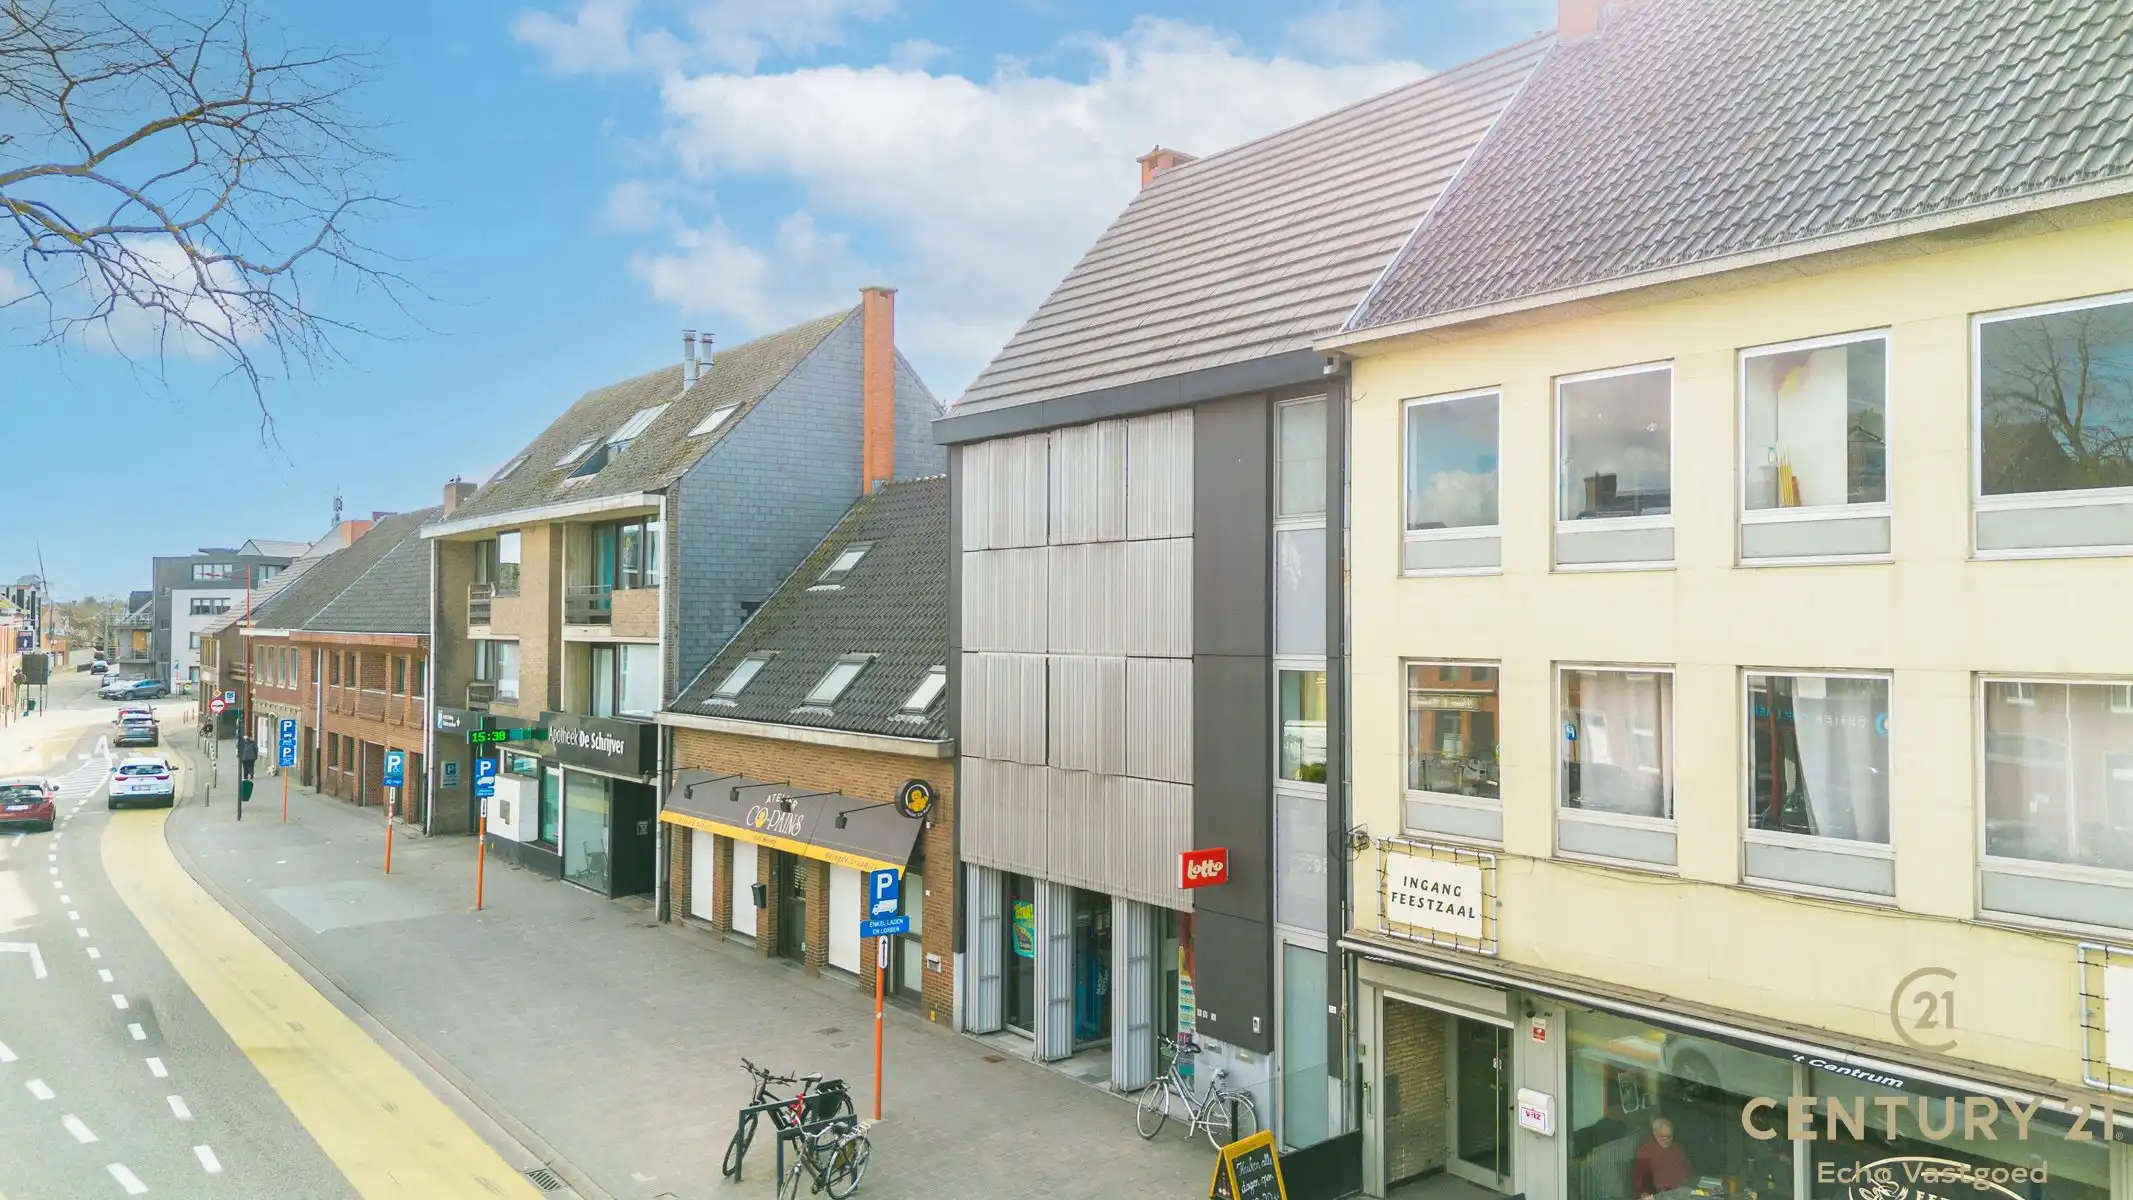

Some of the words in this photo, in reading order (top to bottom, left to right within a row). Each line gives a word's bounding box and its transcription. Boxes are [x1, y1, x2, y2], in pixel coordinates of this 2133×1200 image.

[471, 731, 506, 743] 15:38
[548, 725, 579, 746] Apotheek
[579, 730, 590, 748] De
[590, 731, 625, 757] Schrijver
[387, 755, 401, 773] P
[480, 760, 492, 776] P
[1187, 859, 1224, 880] Lotto
[876, 873, 893, 899] P
[1403, 876, 1462, 897] INGANG
[1391, 891, 1475, 919] FEESTZAAL
[886, 918, 904, 926] LADEN
[1808, 1059, 1905, 1088] Centrum
